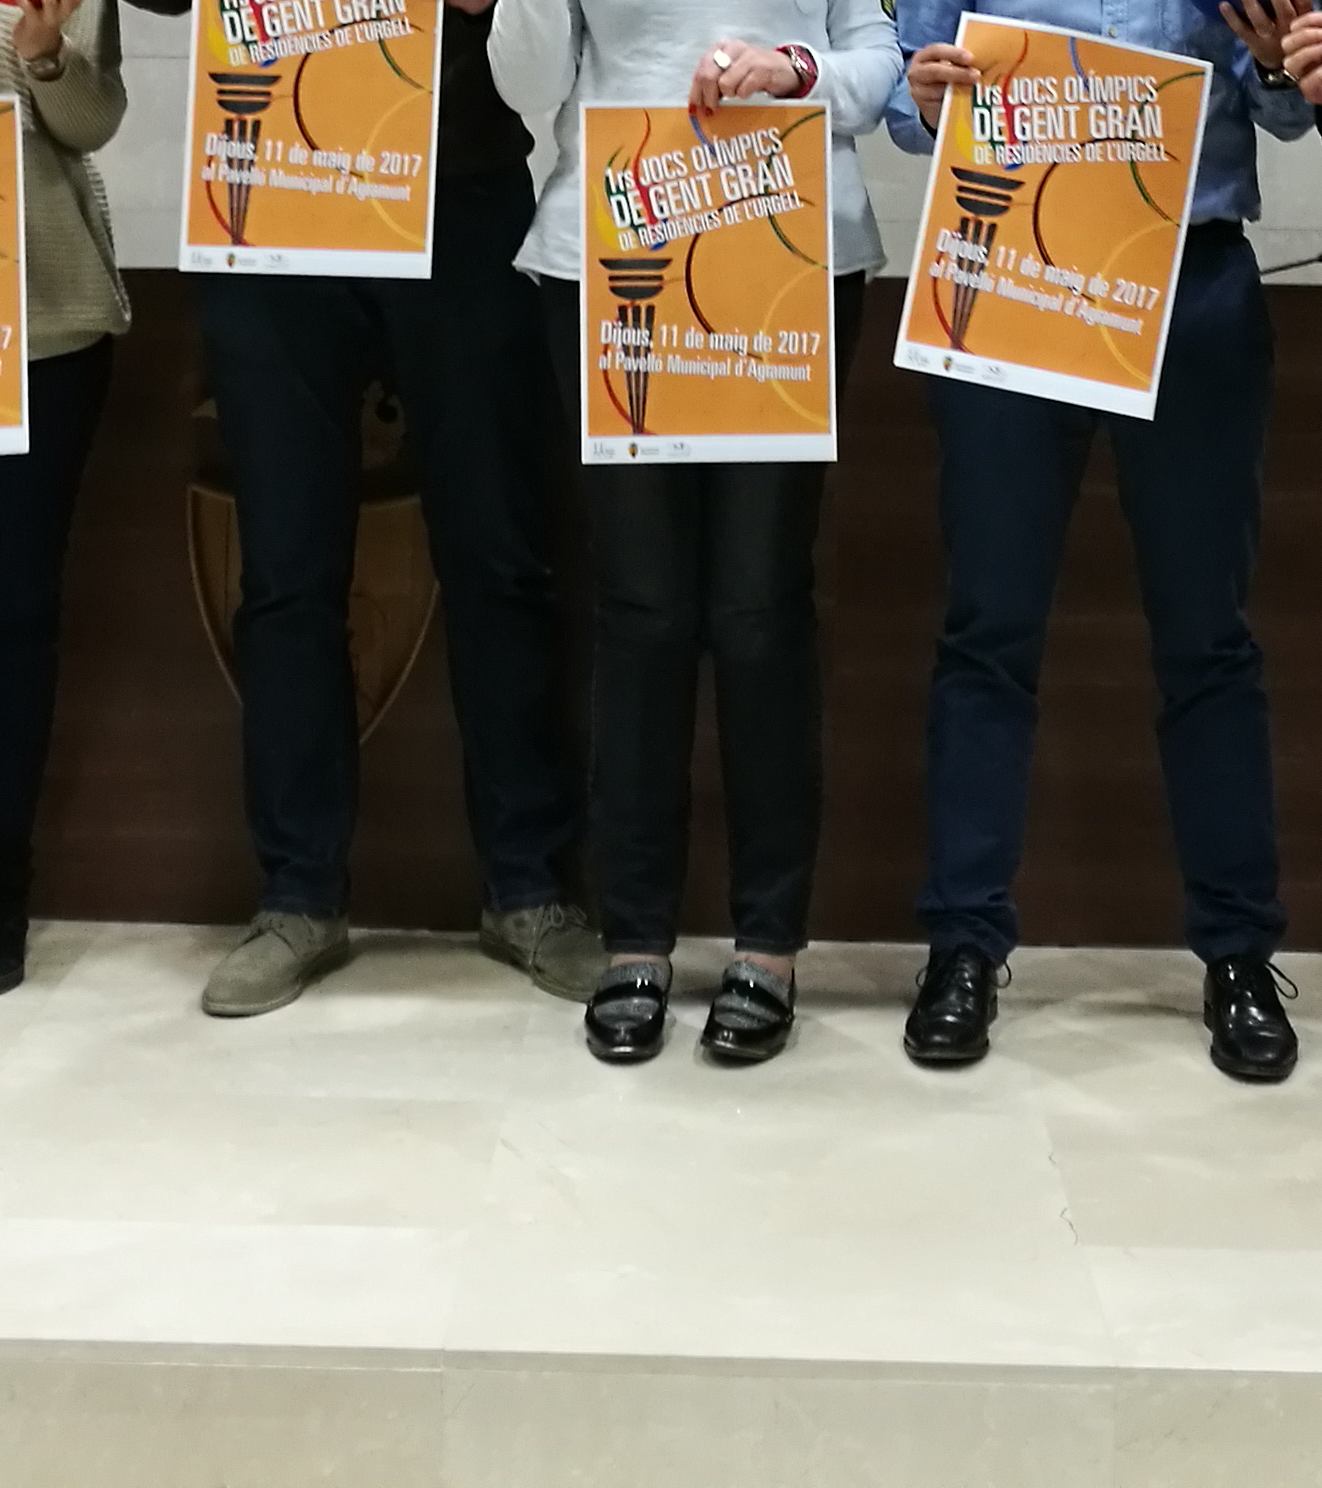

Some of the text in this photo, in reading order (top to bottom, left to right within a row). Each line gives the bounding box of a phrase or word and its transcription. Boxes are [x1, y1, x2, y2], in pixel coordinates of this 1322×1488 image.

[222, 7, 258, 44] DE
[974, 71, 1157, 105] 1rs JOCS OLÍMPICS
[973, 104, 1161, 142] DE GENT GRAN
[604, 129, 783, 193] 1rs JOCS OLÍMPICS
[1086, 142, 1104, 163] DE
[609, 155, 794, 229] DE GENT GRAN
[723, 203, 743, 226] DE
[660, 324, 678, 347] 11
[777, 331, 820, 355] 2017
